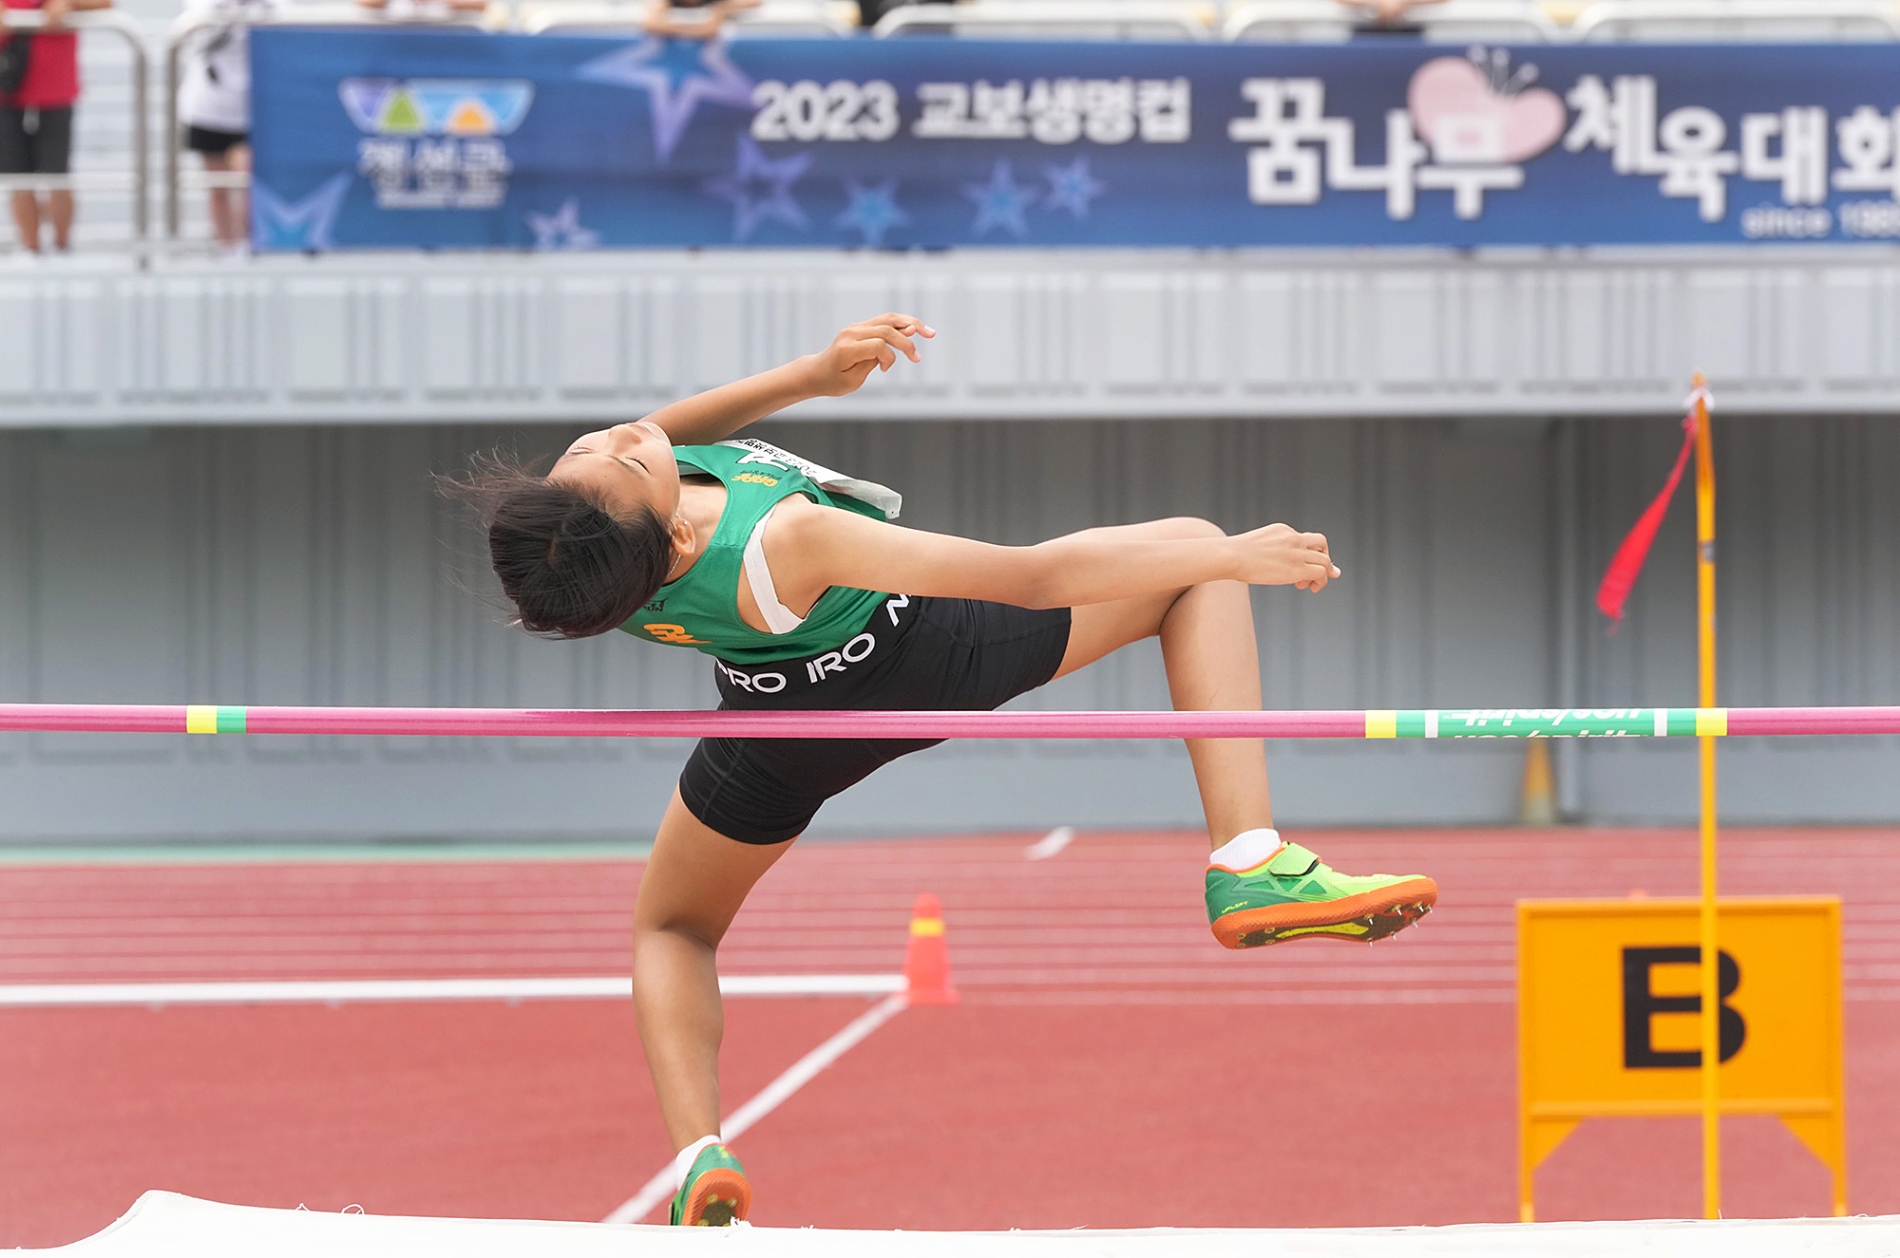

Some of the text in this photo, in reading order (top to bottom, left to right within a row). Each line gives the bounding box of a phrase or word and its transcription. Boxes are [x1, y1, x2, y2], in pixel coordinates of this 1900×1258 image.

[750, 74, 1900, 224] 2023 교보생명컵 꿈나무 체육대회
[1621, 945, 1747, 1070] B
